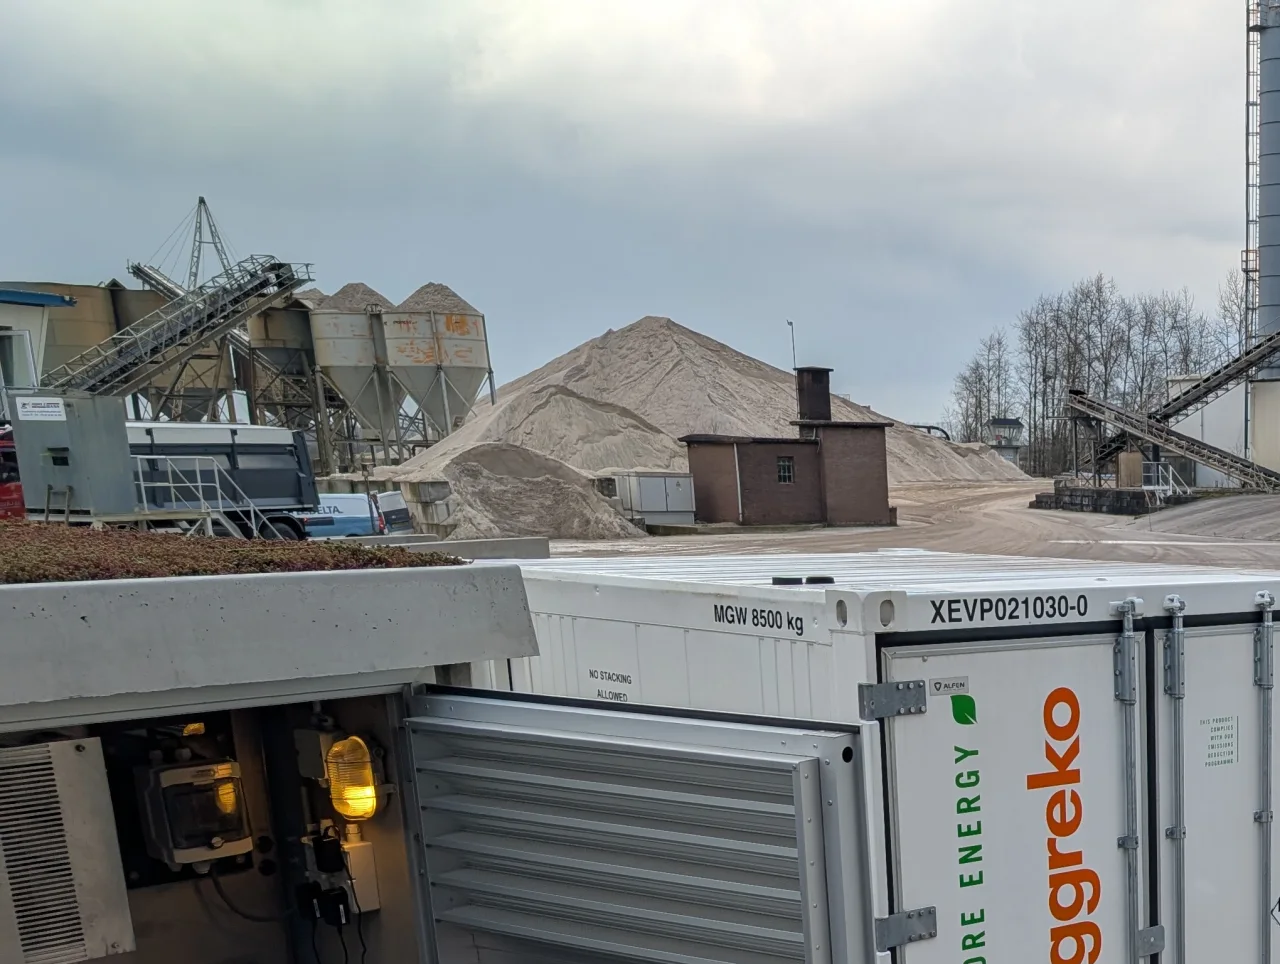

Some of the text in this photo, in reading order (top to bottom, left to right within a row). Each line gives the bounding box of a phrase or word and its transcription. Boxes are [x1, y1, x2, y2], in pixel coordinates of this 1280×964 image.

[713, 604, 804, 636] MGW 8500 kg
[930, 594, 1088, 624] XEVP021030-0
[588, 668, 632, 685] NO STACKING
[943, 681, 965, 690] ALFEN
[596, 688, 628, 702] ALLOWED
[954, 745, 984, 888] ENERGY
